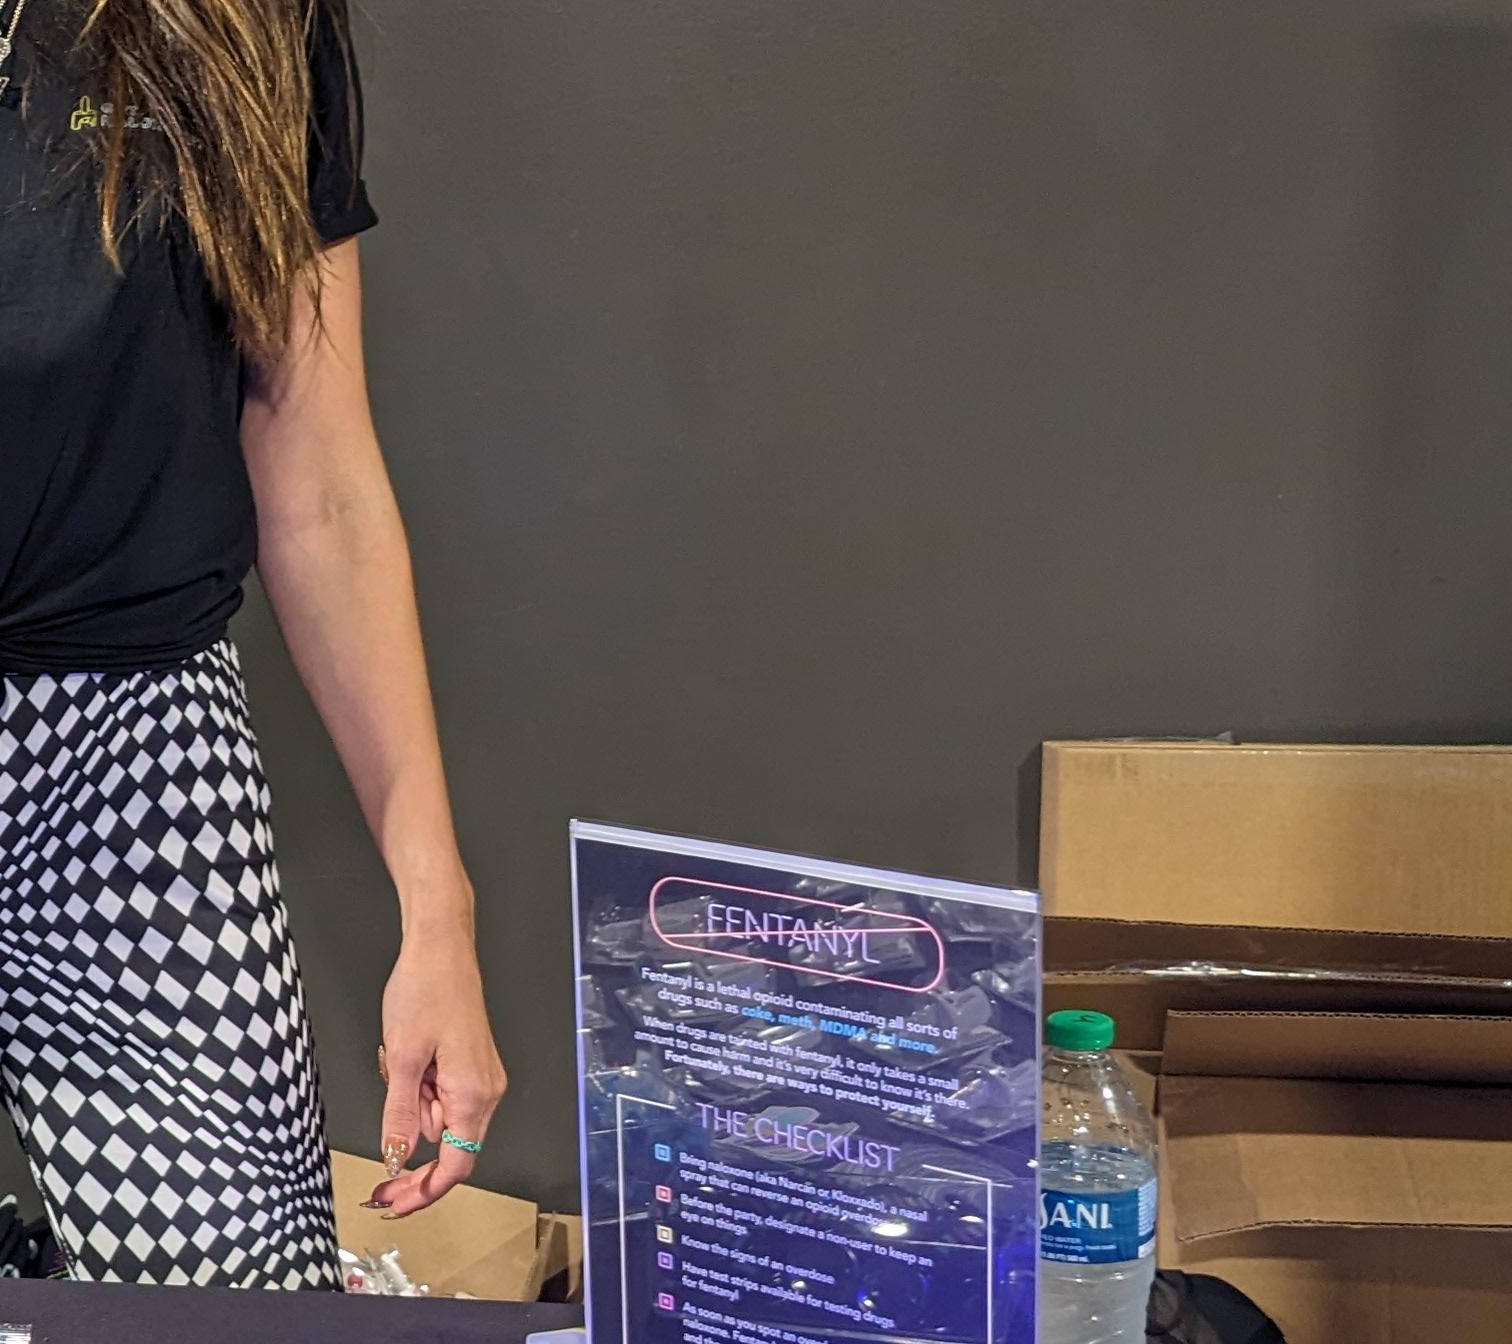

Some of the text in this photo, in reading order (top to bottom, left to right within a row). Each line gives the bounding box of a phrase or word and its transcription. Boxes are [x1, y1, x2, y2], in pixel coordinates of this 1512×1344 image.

[707, 903, 880, 964] FENTANYL
[642, 967, 958, 1040] Fentanyl is a lethal opioid contaminating all sorts of
[658, 987, 693, 1006] drugs
[694, 997, 722, 1010] such
[724, 1003, 738, 1014] as
[819, 1018, 867, 1040] MDMA
[869, 1031, 896, 1045] and
[898, 1038, 940, 1055] more.
[634, 1031, 675, 1047] amount
[676, 1038, 689, 1049] to
[690, 1042, 721, 1056] cause
[722, 1047, 751, 1062] harm
[752, 1056, 775, 1067] and
[795, 1065, 818, 1080] very
[820, 1067, 864, 1087] difficult
[865, 1077, 879, 1090] to
[880, 1079, 913, 1097] know
[643, 1015, 675, 1031] When
[676, 1022, 708, 1040] drugs
[709, 1031, 727, 1042] are
[728, 1034, 768, 1051] tainted
[769, 1043, 794, 1056] with
[846, 1057, 856, 1069] it
[857, 1061, 882, 1077] only
[883, 1066, 917, 1082] takes
[928, 1076, 960, 1090] small
[733, 1065, 765, 1081] there
[765, 1074, 786, 1085] are
[787, 1078, 818, 1093] ways
[819, 1084, 834, 1095] to
[835, 1088, 880, 1106] protect
[694, 1102, 901, 1172] THE CHECKLIST
